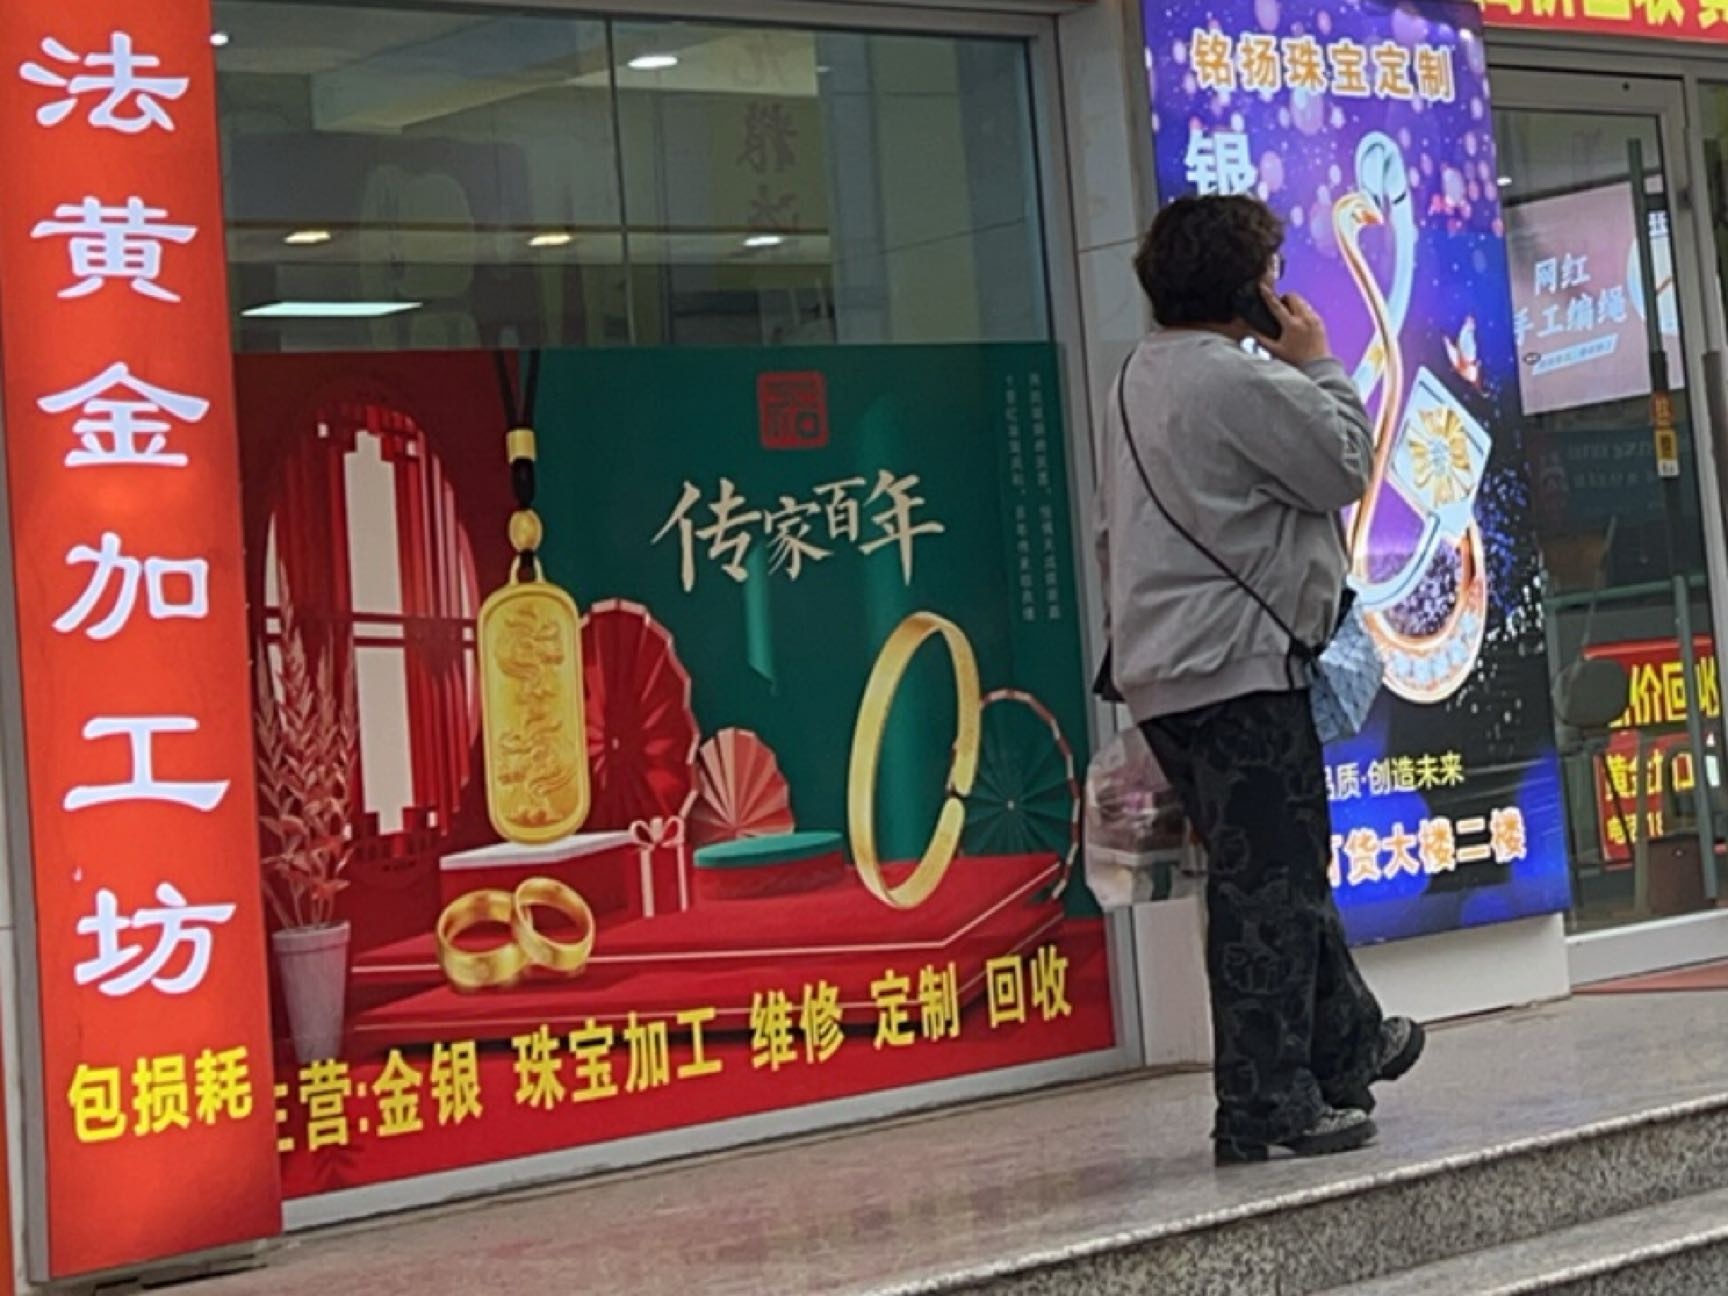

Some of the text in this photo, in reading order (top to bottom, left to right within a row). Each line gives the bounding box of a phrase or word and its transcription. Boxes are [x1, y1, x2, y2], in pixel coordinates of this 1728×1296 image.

[1190, 27, 1456, 102] 铭扬珠宝定制
[652, 468, 946, 593] 传家百年
[513, 1007, 723, 1111] 珠宝加工
[750, 981, 844, 1072] 维修
[870, 961, 962, 1052] 定制
[985, 943, 1072, 1029] 回收
[68, 1045, 255, 1145] 包损耗
